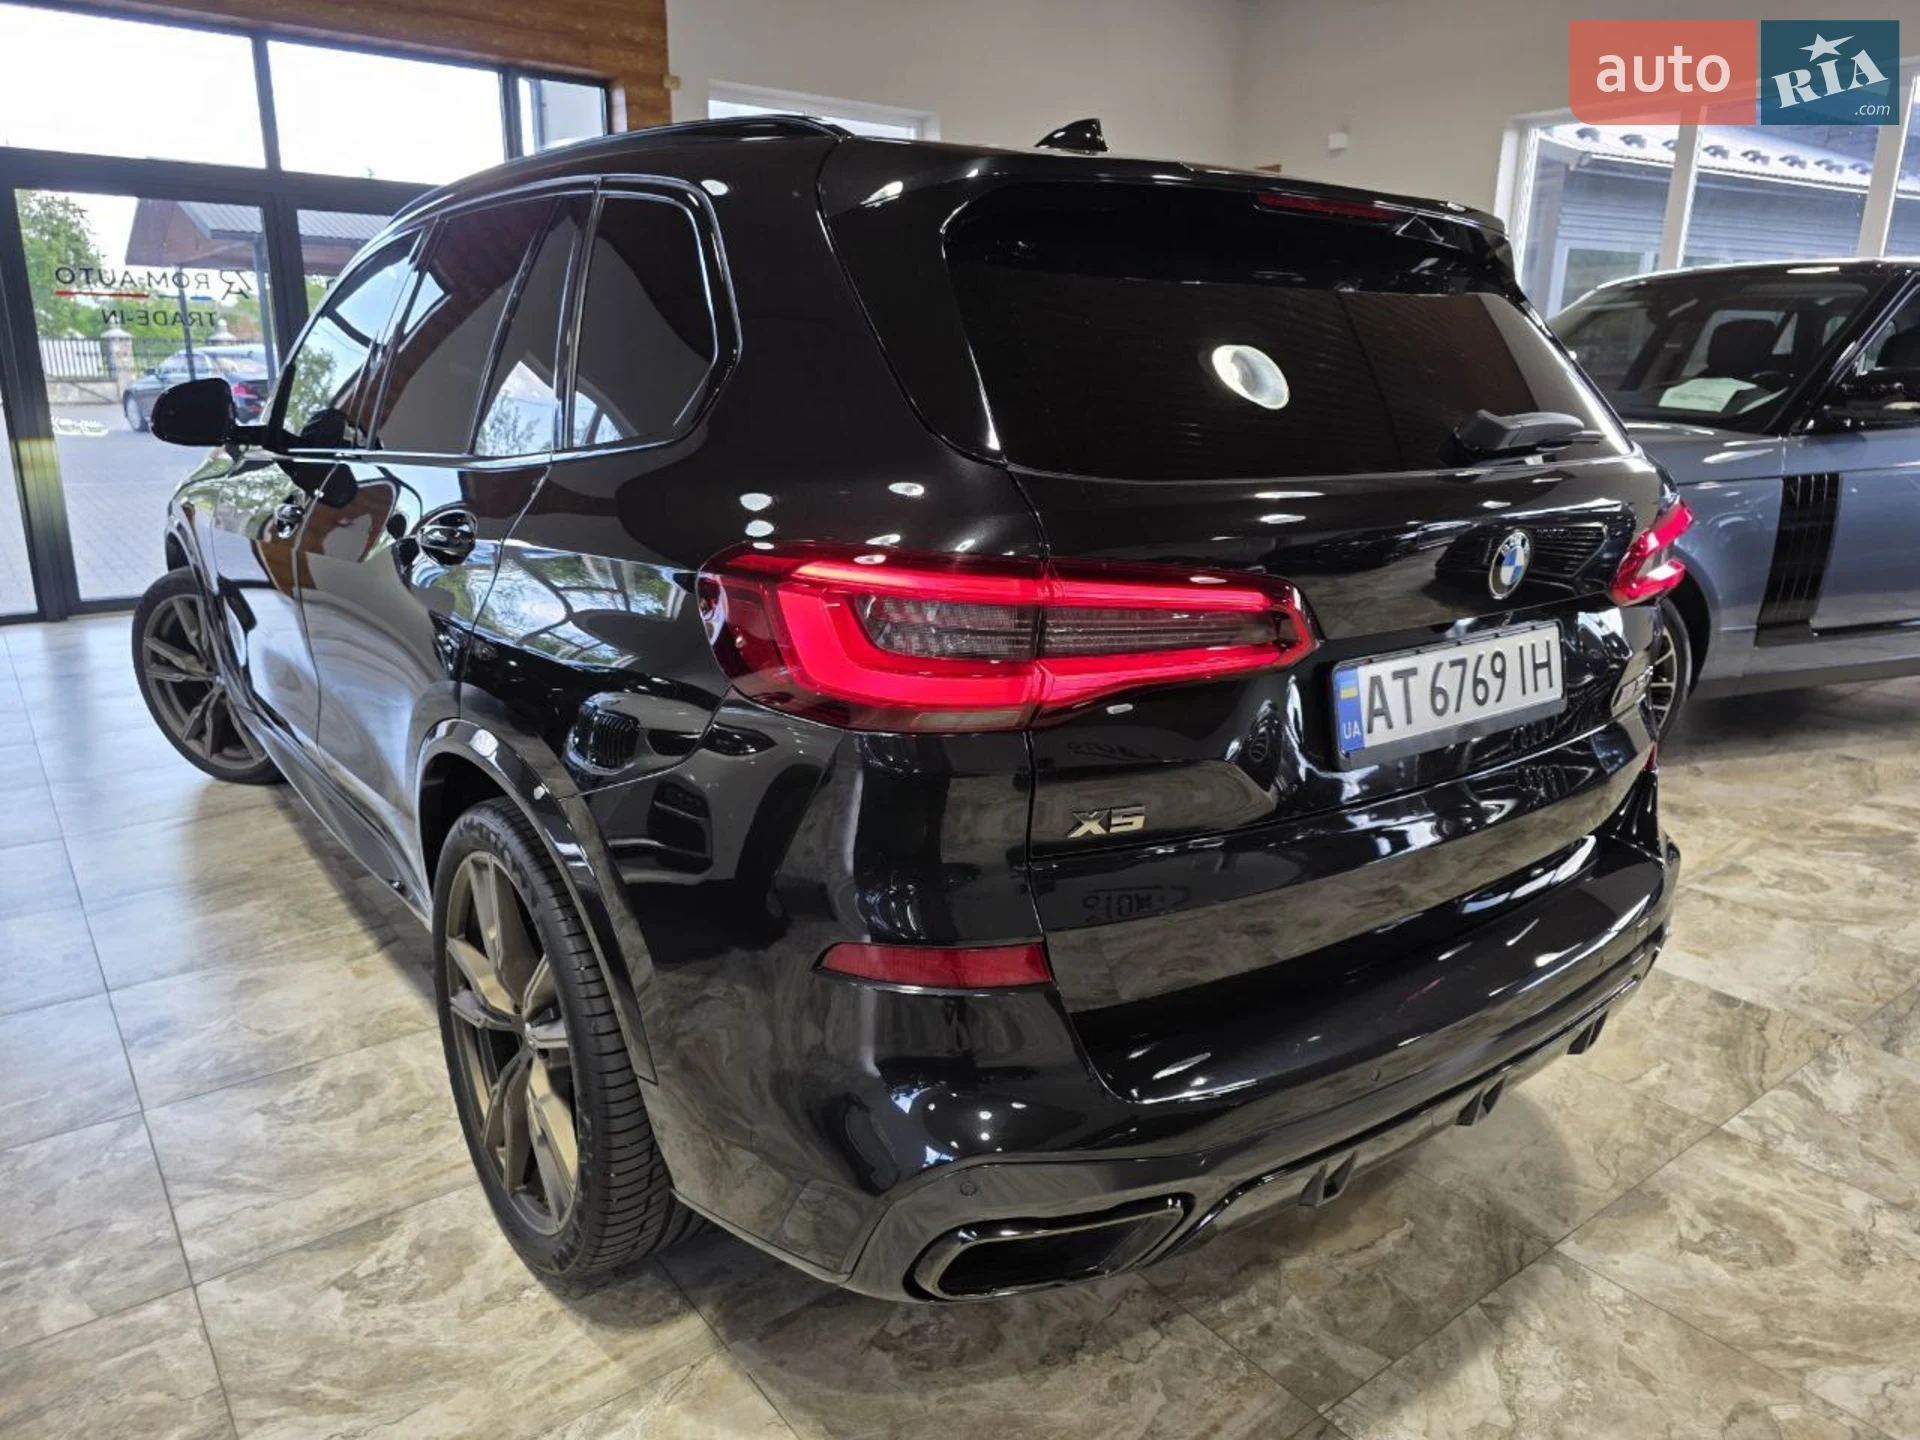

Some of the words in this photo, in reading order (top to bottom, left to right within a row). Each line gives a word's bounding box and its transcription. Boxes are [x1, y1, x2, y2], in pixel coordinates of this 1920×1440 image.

[1367, 666, 1418, 734] AT
[1430, 650, 1507, 717] 6769
[1519, 638, 1554, 697] IH
[1342, 721, 1362, 739] UA
[1068, 804, 1146, 839] X5
